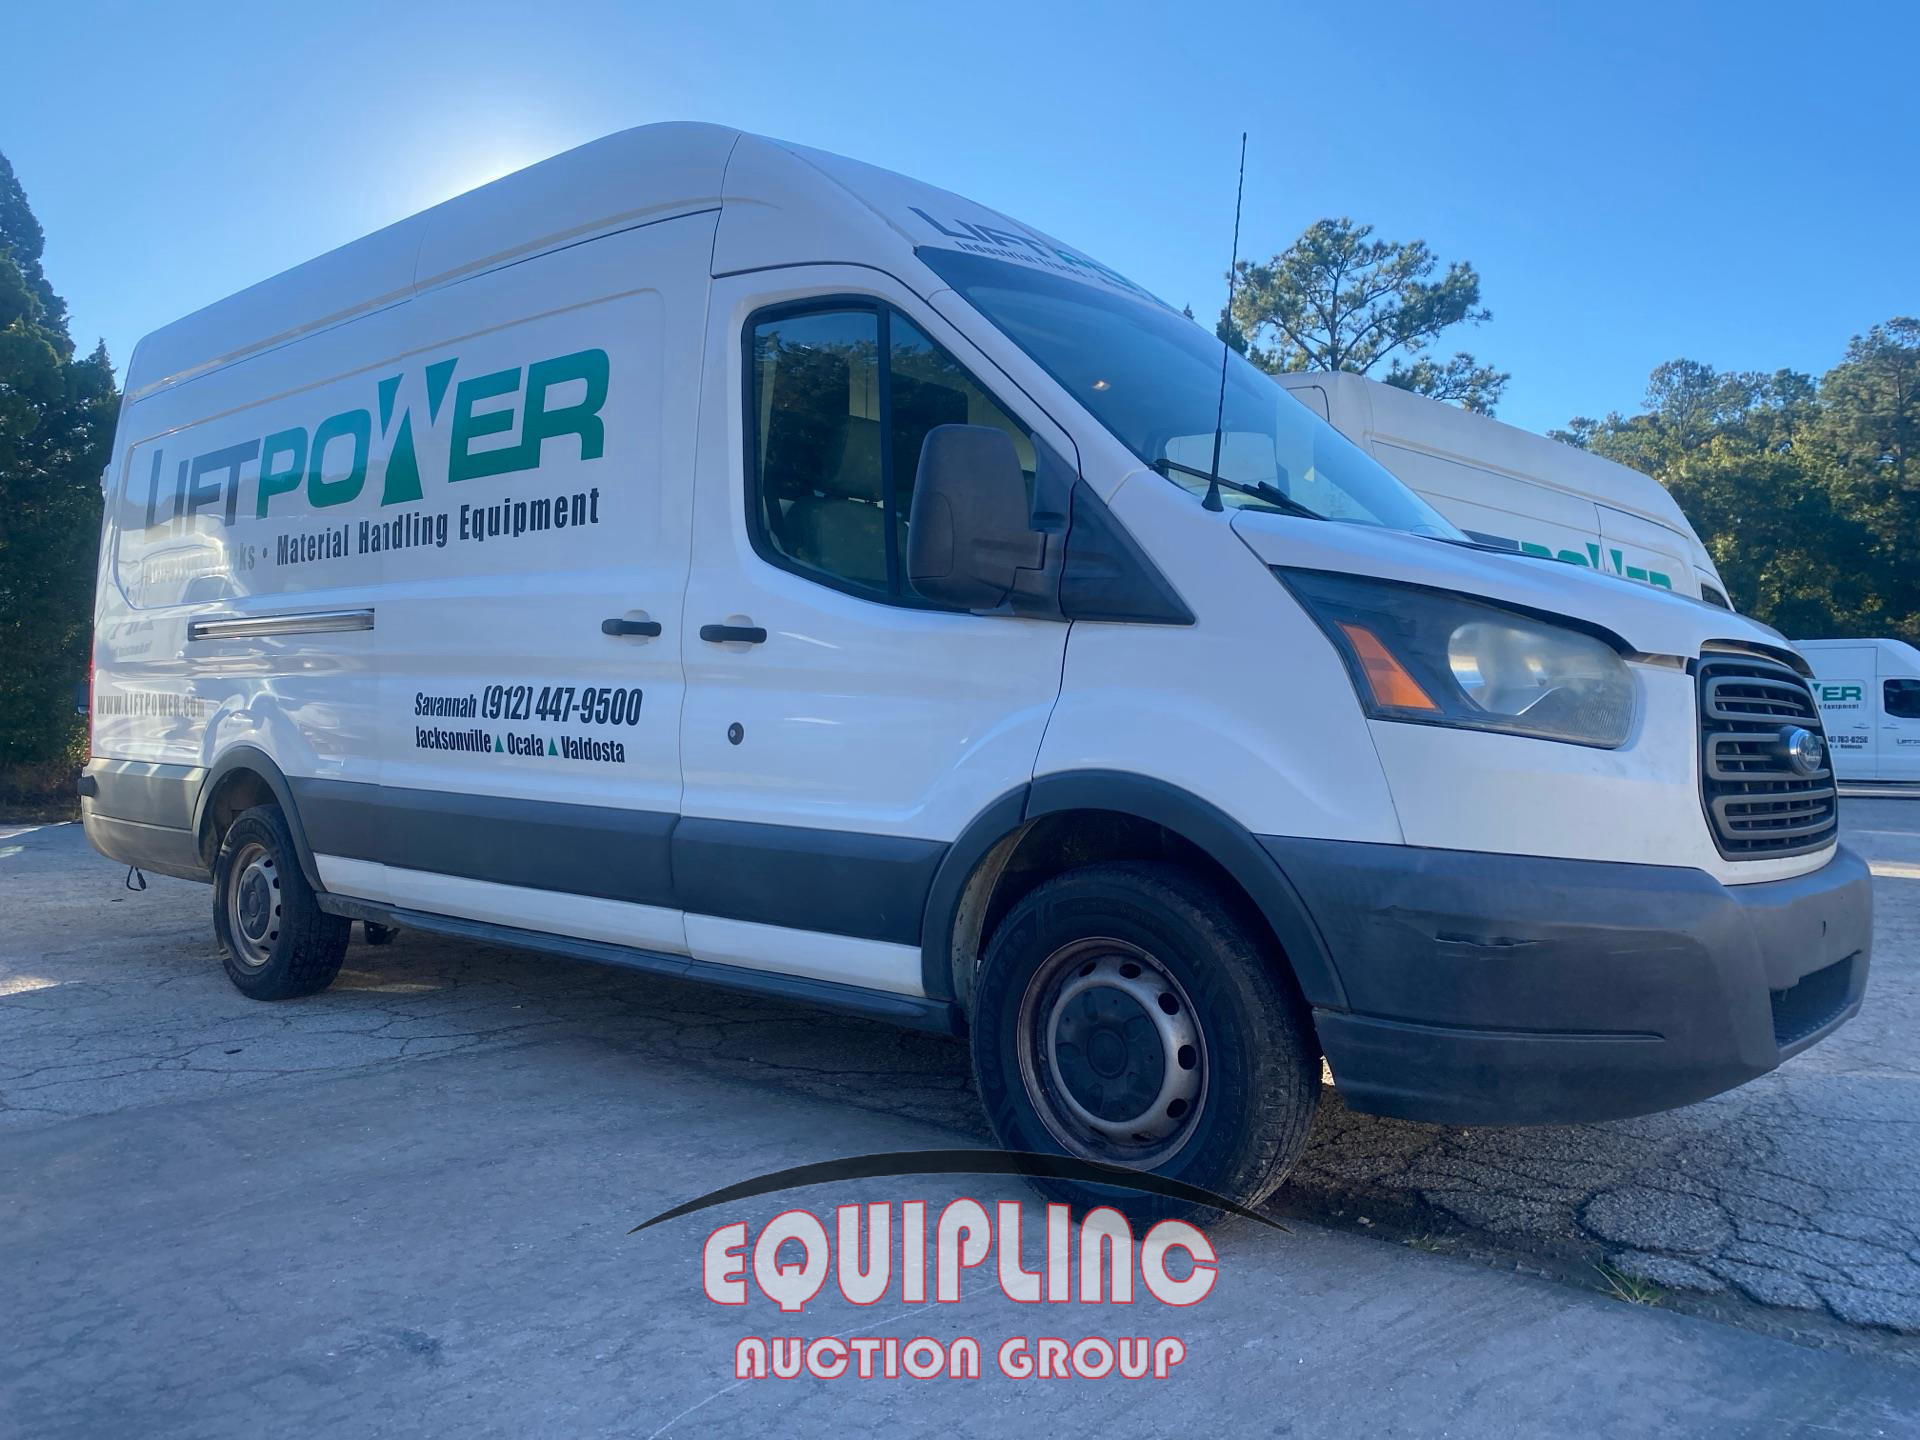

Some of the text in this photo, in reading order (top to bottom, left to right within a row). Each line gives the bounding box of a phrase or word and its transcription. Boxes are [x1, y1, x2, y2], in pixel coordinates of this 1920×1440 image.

[145, 348, 610, 541] LIFTPOWER
[276, 525, 349, 567] Material
[358, 509, 448, 554] Handling
[459, 487, 600, 541] Equipment
[414, 684, 643, 726] Savannah (912) 447-9500
[415, 725, 625, 763] Jacksonville Ocala Valdosta
